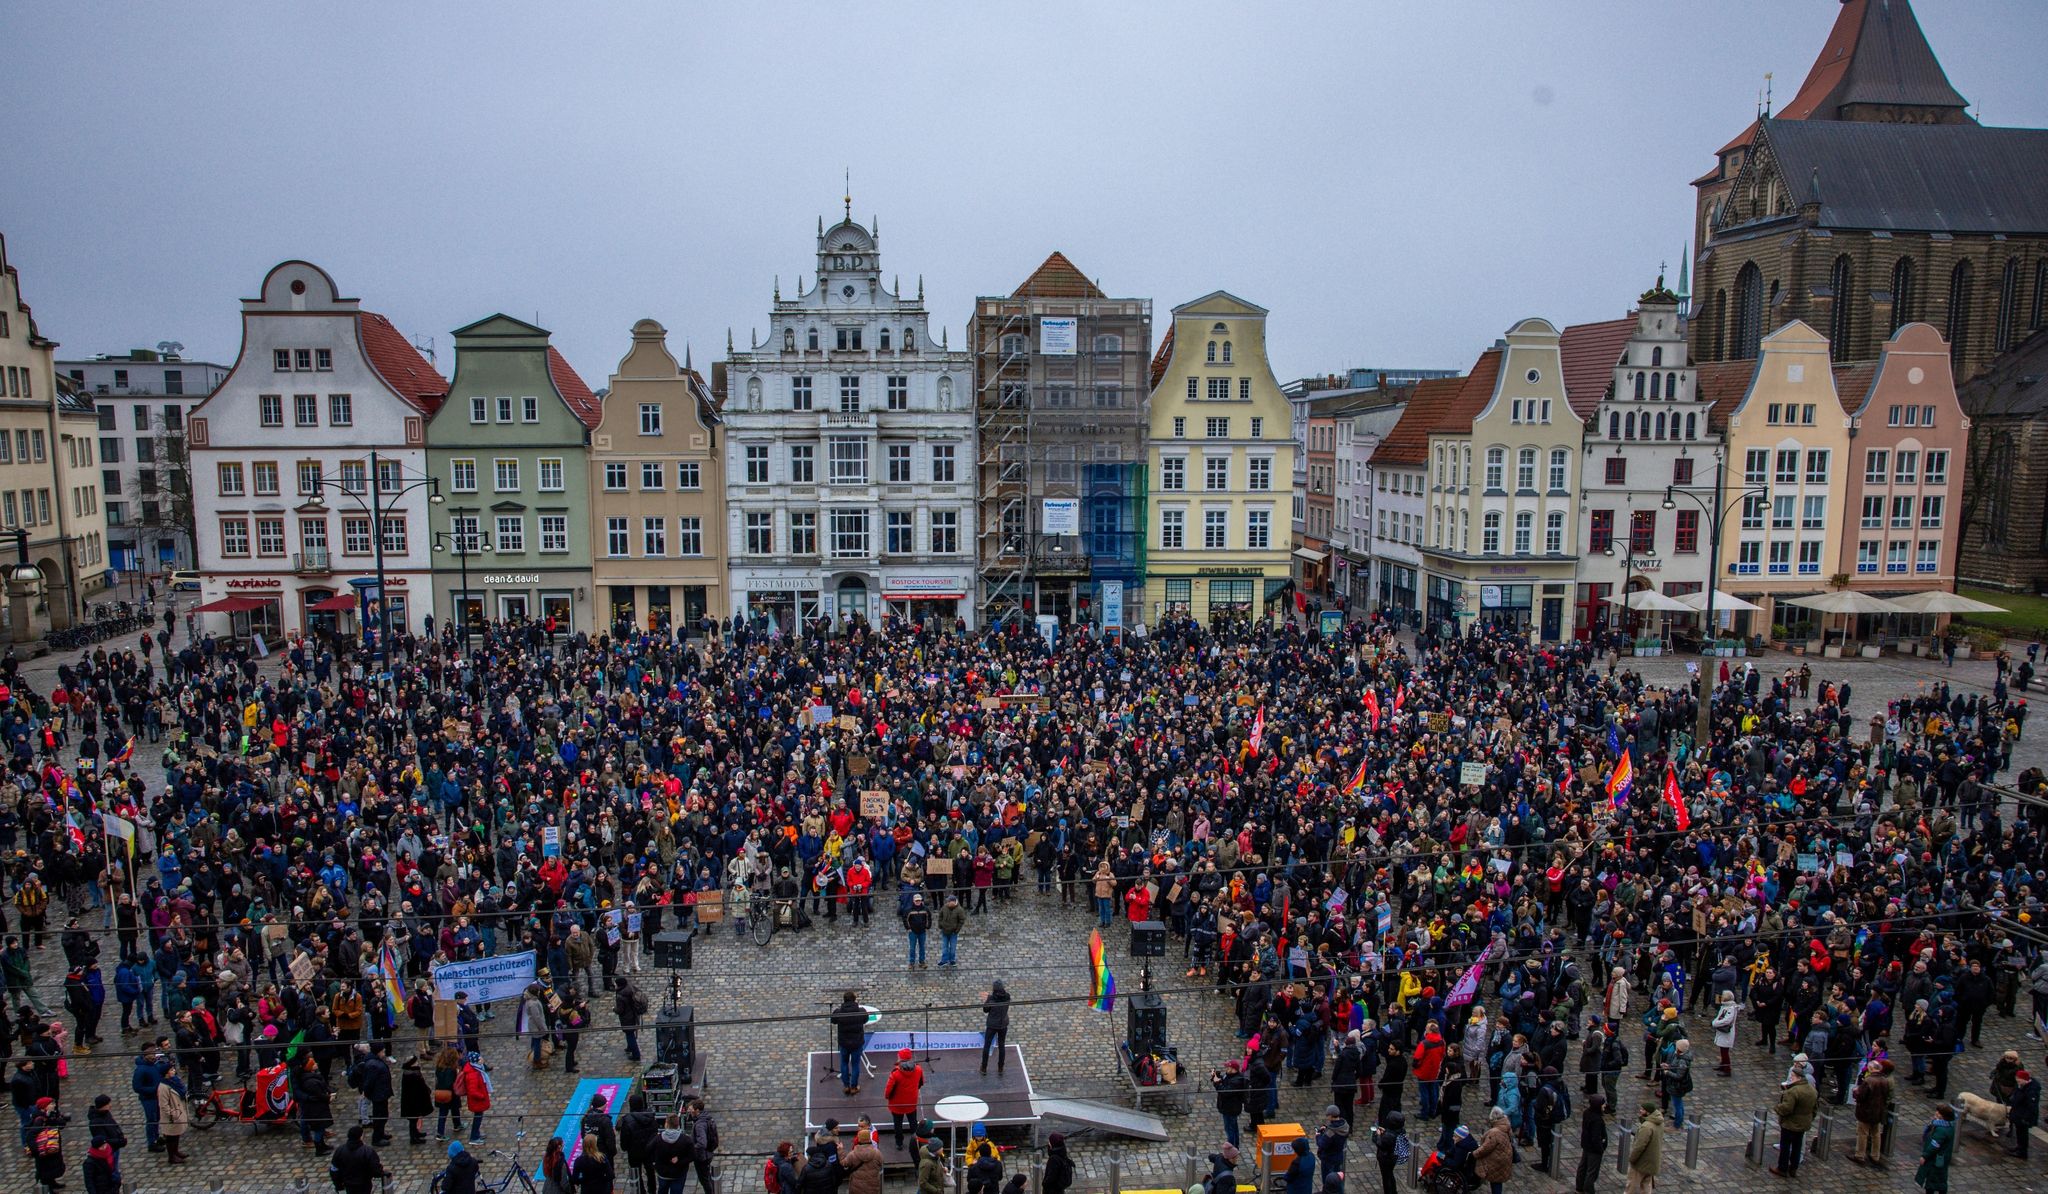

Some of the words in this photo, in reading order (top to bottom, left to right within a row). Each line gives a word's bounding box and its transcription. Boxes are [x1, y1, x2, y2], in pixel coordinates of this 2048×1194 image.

[226, 577, 281, 589] VAPIANO
[748, 579, 815, 588] FESTMODEN
[439, 965, 487, 982] Menschen
[489, 958, 533, 973] schützen
[453, 979, 476, 989] statt
[477, 972, 516, 986] Grenzen!
